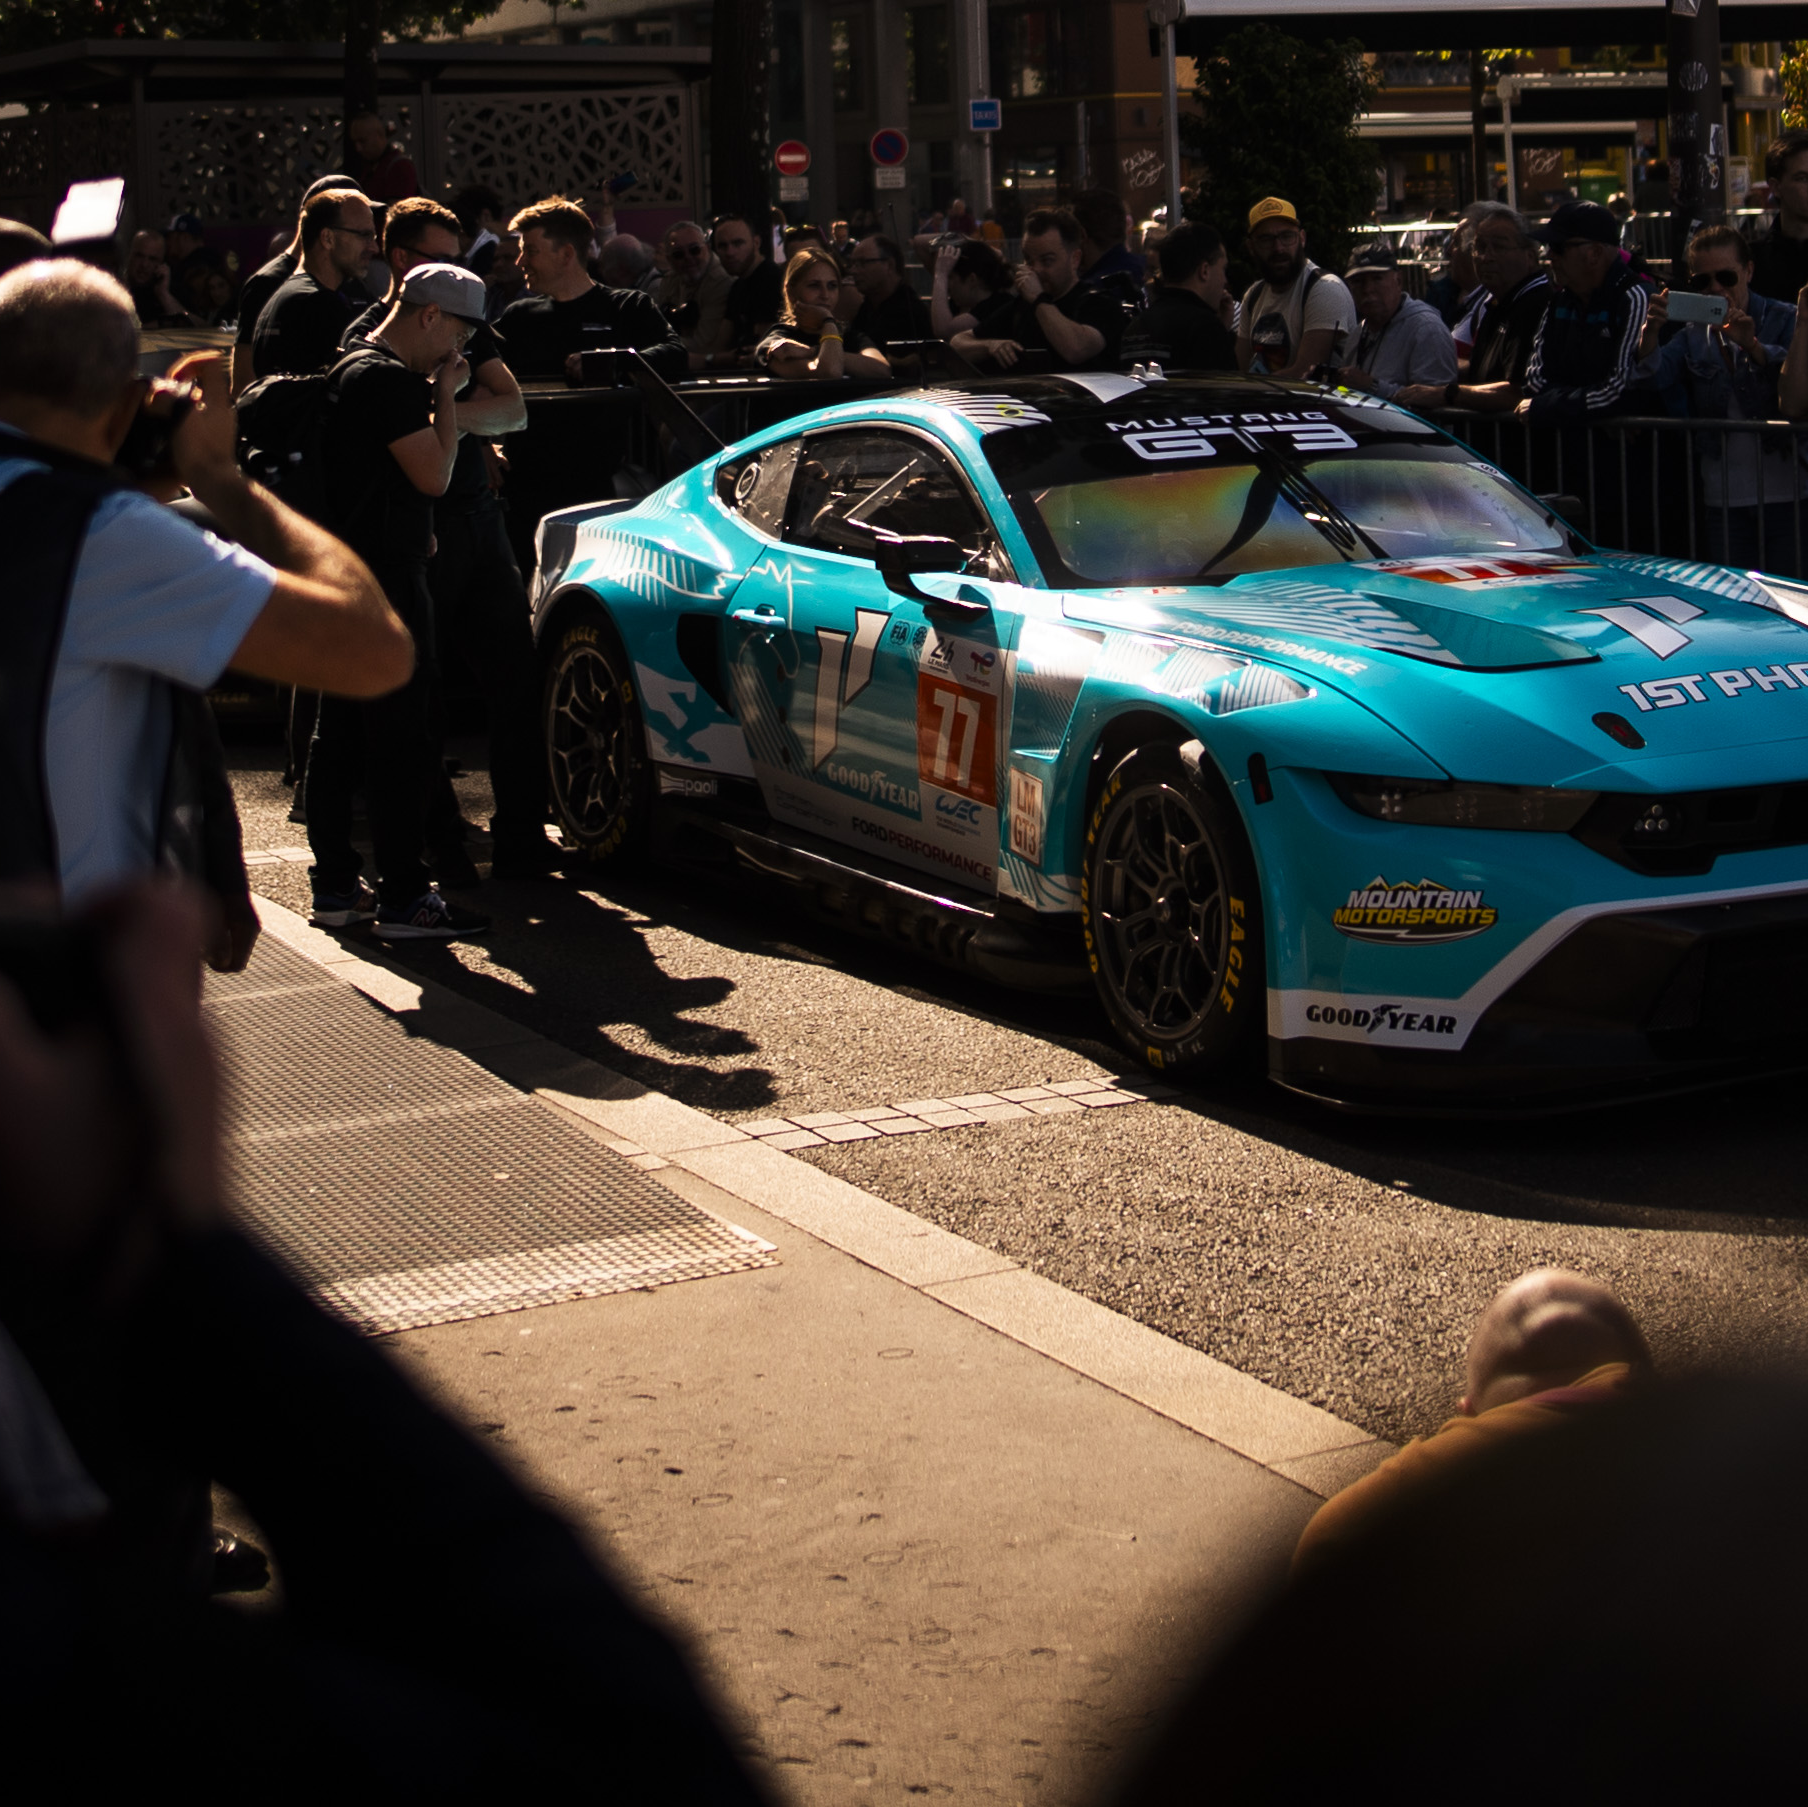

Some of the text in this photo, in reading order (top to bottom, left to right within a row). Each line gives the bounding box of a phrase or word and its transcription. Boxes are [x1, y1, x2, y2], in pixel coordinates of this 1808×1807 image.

[974, 110, 997, 121] TAXIS
[1104, 411, 1329, 432] MUSTANG
[1122, 423, 1359, 460] GT3
[562, 625, 600, 652] EAGLE
[1617, 673, 1709, 712] 1ST
[934, 687, 982, 790] 77
[684, 779, 718, 796] paoli
[1016, 784, 1036, 818] LM
[935, 794, 982, 825] WEC
[1013, 816, 1037, 856] GT3
[1346, 889, 1484, 910] MOUNTAIN
[1333, 908, 1497, 925] MOTORSPORTS
[1219, 895, 1246, 1014] EAGLE
